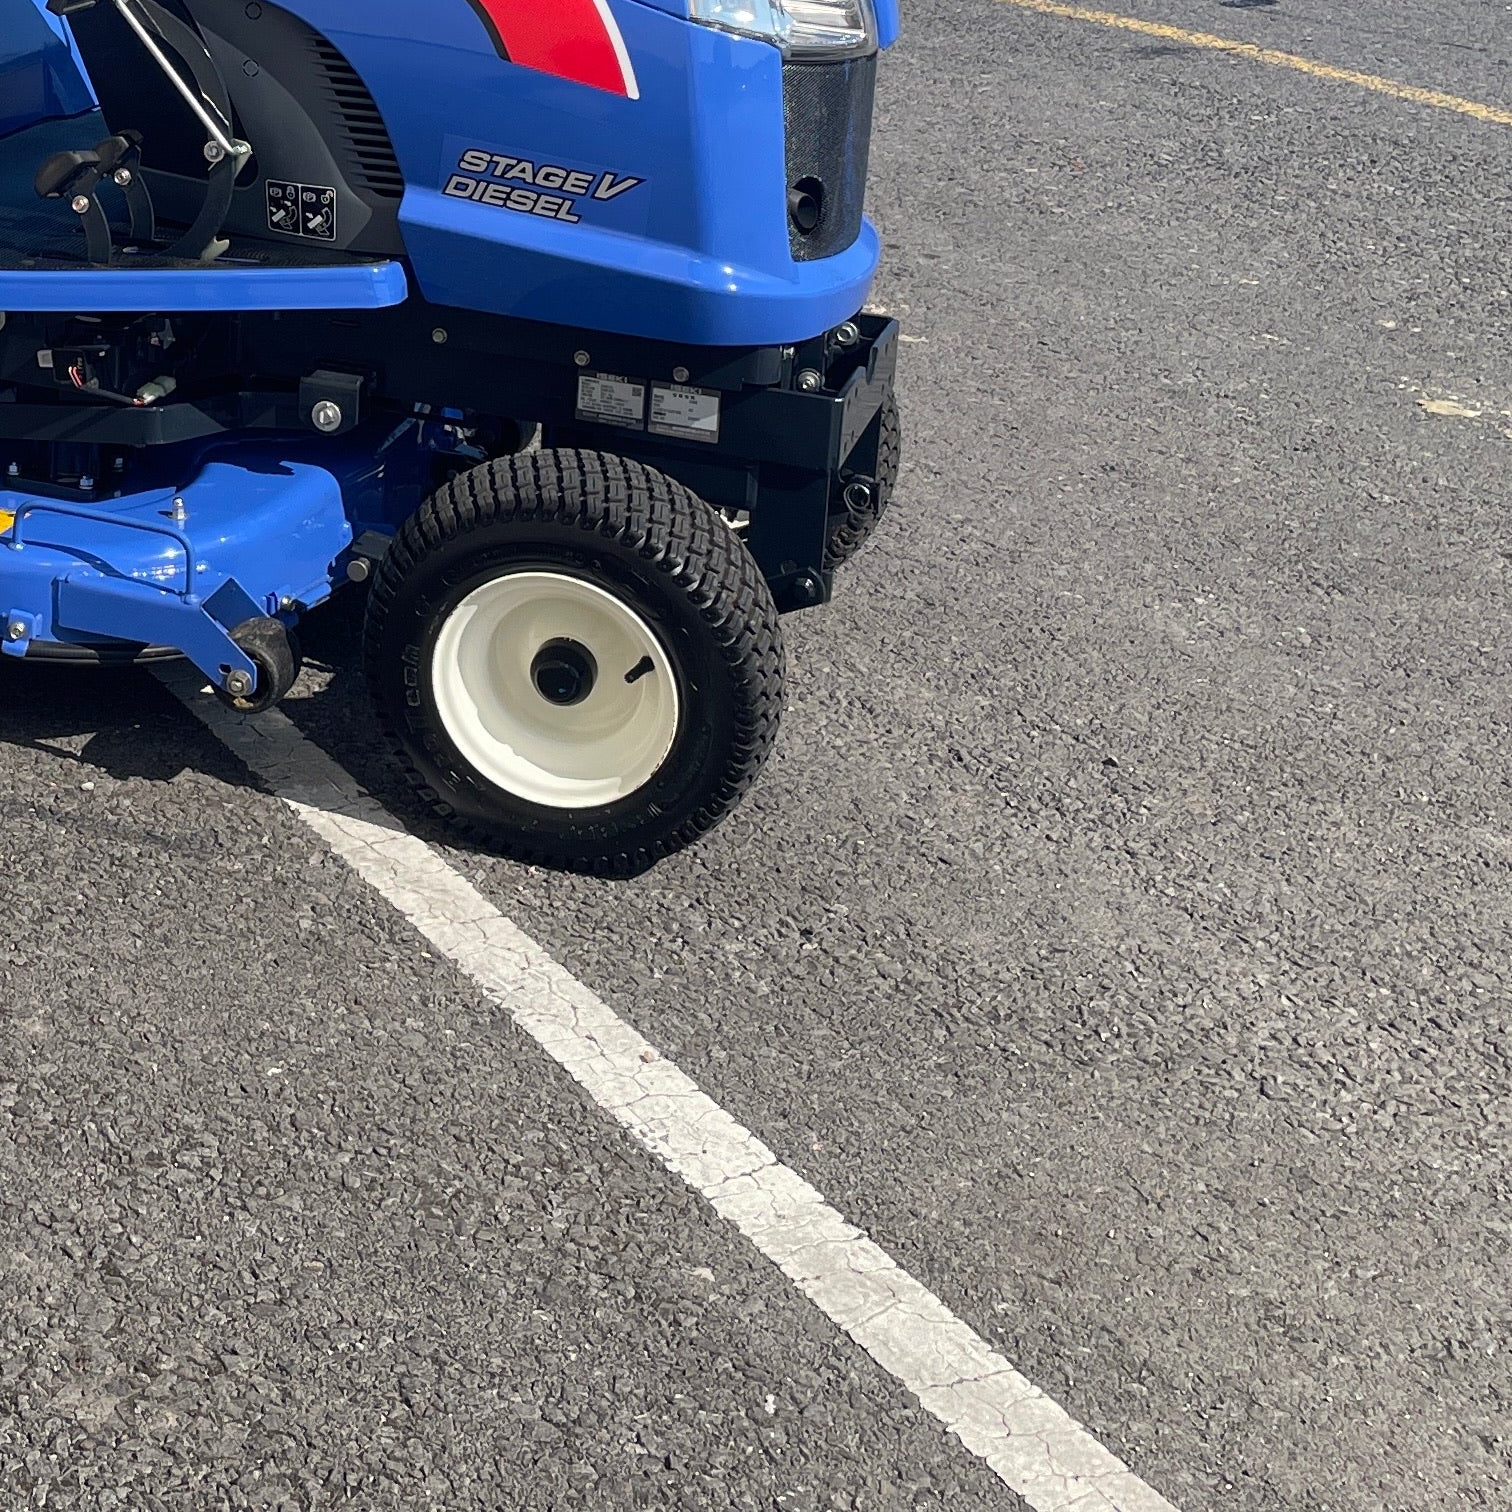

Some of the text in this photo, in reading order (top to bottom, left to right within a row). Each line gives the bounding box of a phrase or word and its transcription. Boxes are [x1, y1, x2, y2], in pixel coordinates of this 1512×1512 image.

[442, 173, 581, 224] DIESEL
[458, 149, 646, 201] STAGE V
